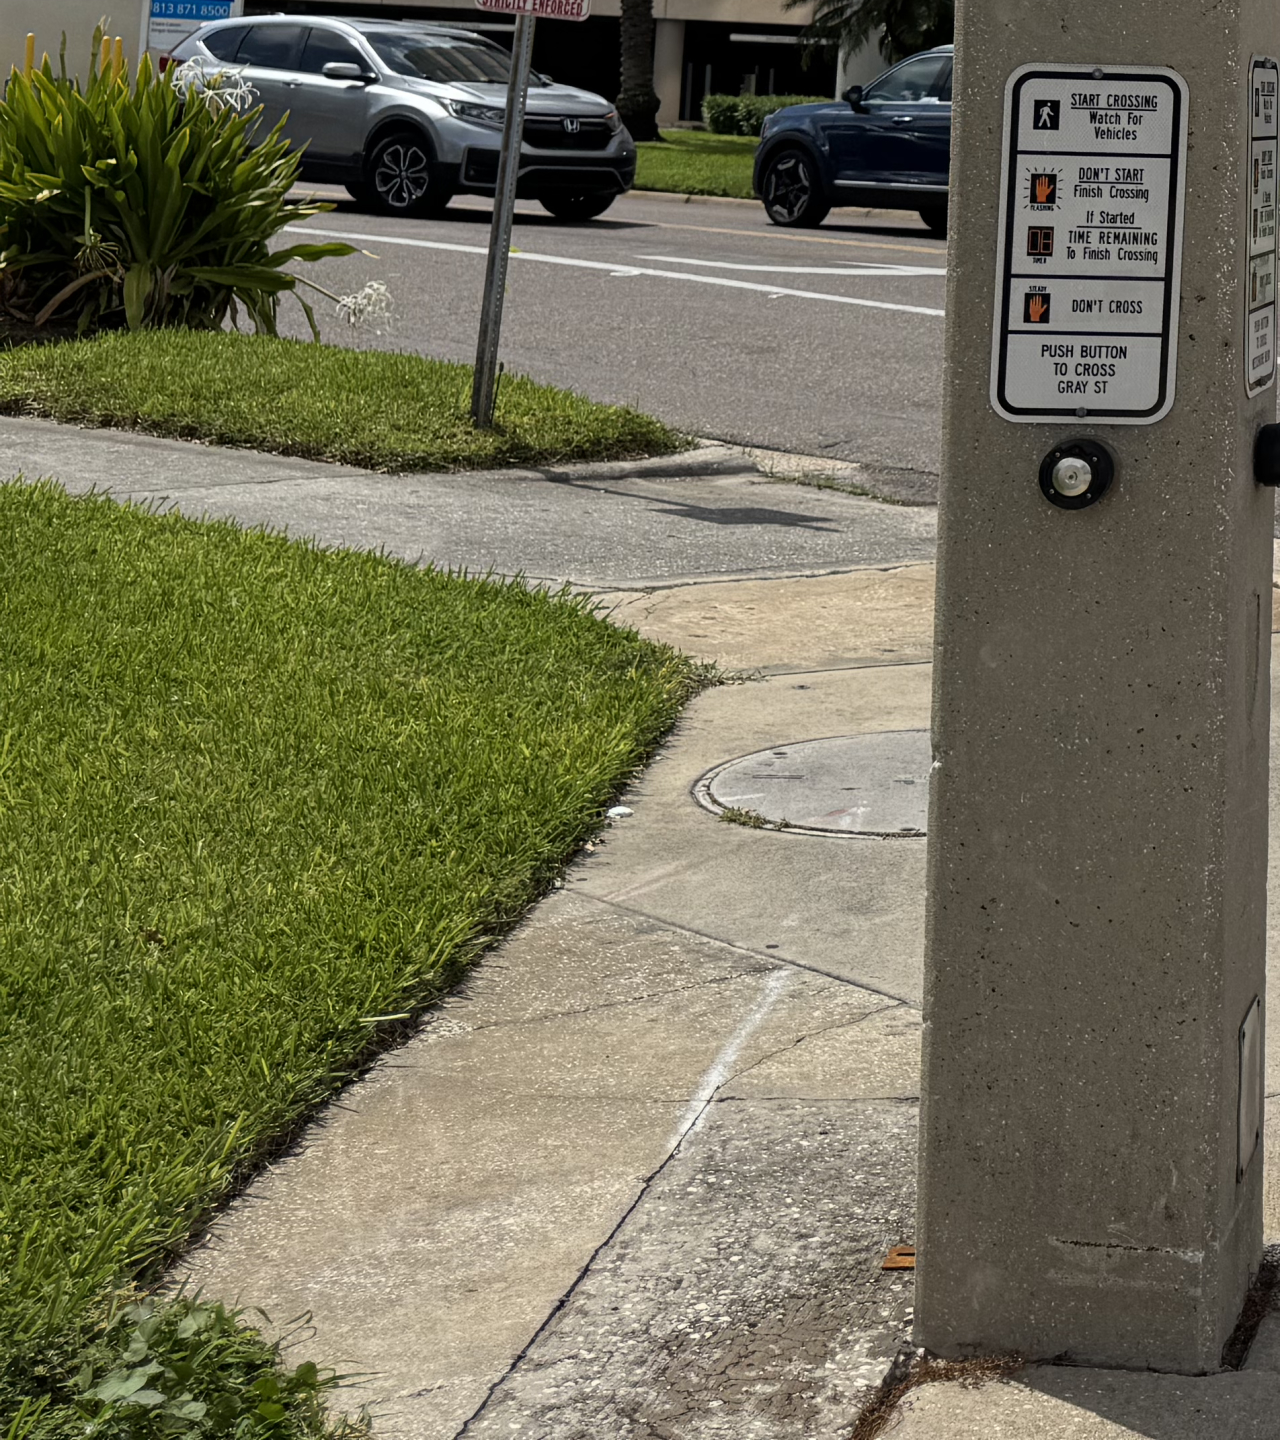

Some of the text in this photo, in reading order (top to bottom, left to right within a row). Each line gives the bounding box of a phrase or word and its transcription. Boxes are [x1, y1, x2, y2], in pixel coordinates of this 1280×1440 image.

[153, 2, 228, 17] 813 871 8500
[1071, 93, 1158, 108] START CROSSING
[1089, 111, 1143, 125] Watch For
[1094, 127, 1137, 140] Vehicles
[1078, 167, 1144, 182] DON'T START
[1074, 185, 1149, 203] Finish Crossing
[1086, 210, 1135, 225] If Started
[1068, 231, 1158, 246] TIME REMAINING
[1066, 246, 1158, 265] To Finish Crossing
[1072, 299, 1143, 314] DON'T CROSS
[1041, 344, 1127, 359] PUSH BUTTON
[1053, 362, 1116, 377] TO CROSS
[1057, 380, 1108, 394] GRAY ST
